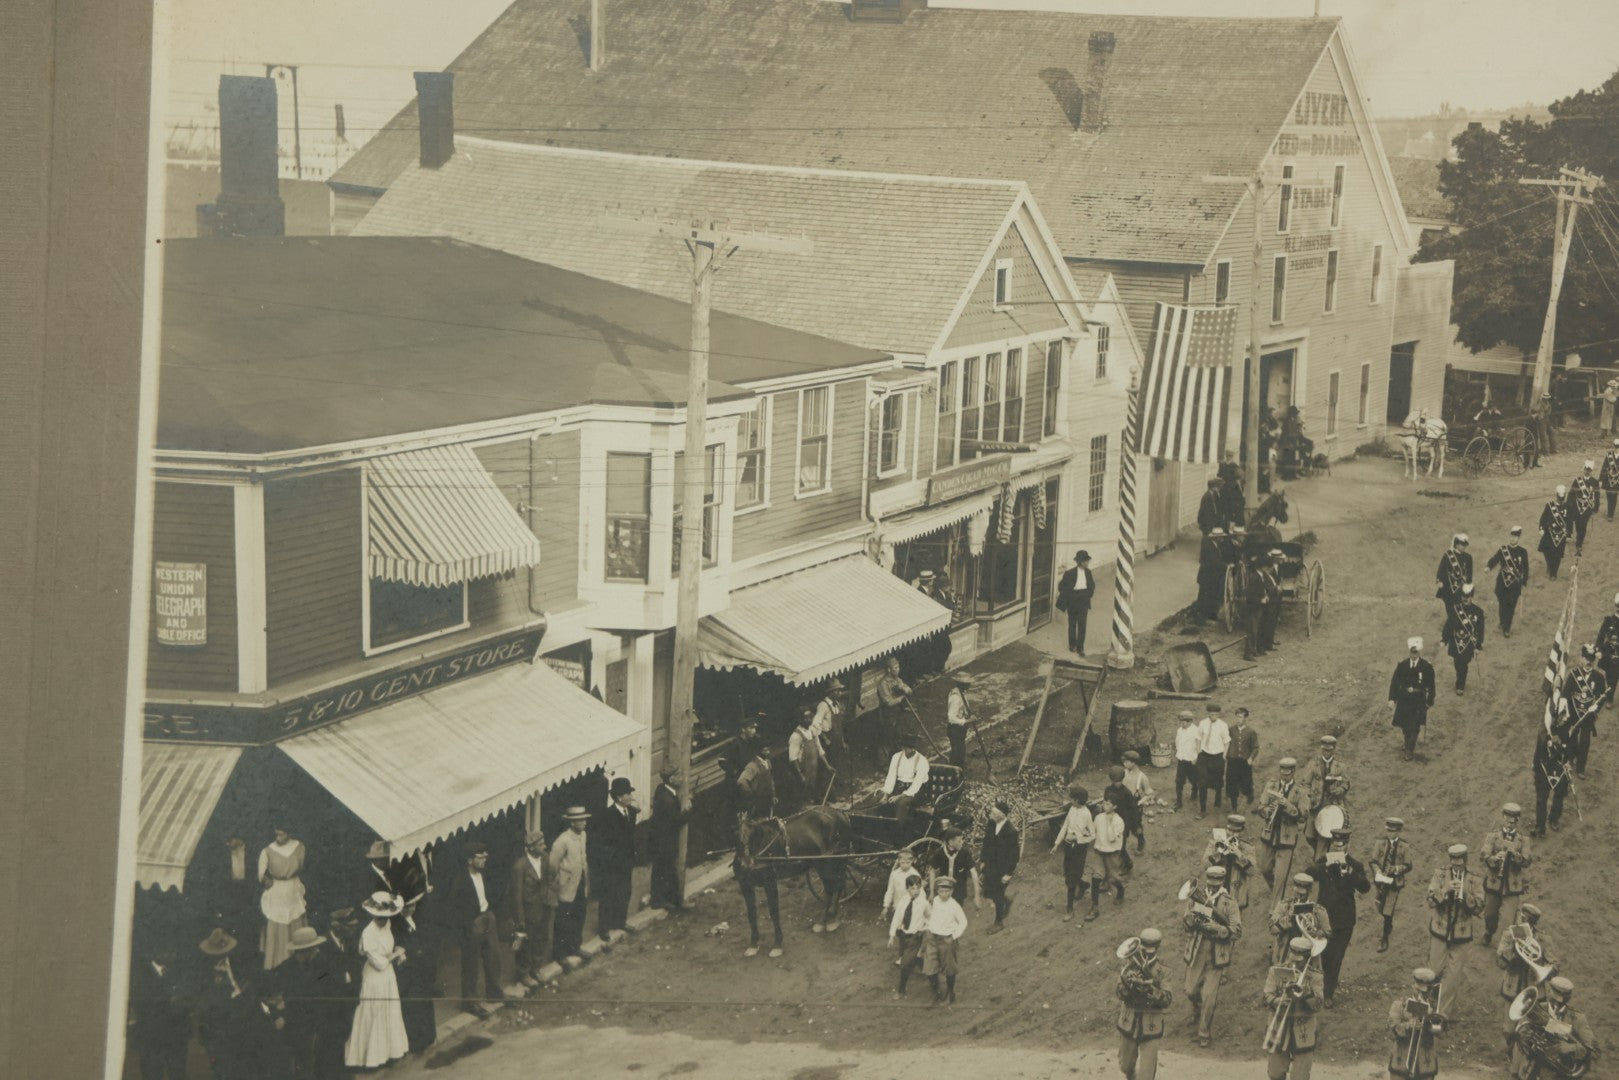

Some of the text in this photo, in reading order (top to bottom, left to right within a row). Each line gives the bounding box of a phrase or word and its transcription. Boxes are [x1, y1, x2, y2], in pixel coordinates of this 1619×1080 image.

[1272, 133, 1298, 155] EED
[160, 583, 194, 596] UNION
[166, 617, 188, 629] AND
[176, 629, 206, 641] OFFICE
[281, 638, 526, 730] 5 & 10 CENT STORE
